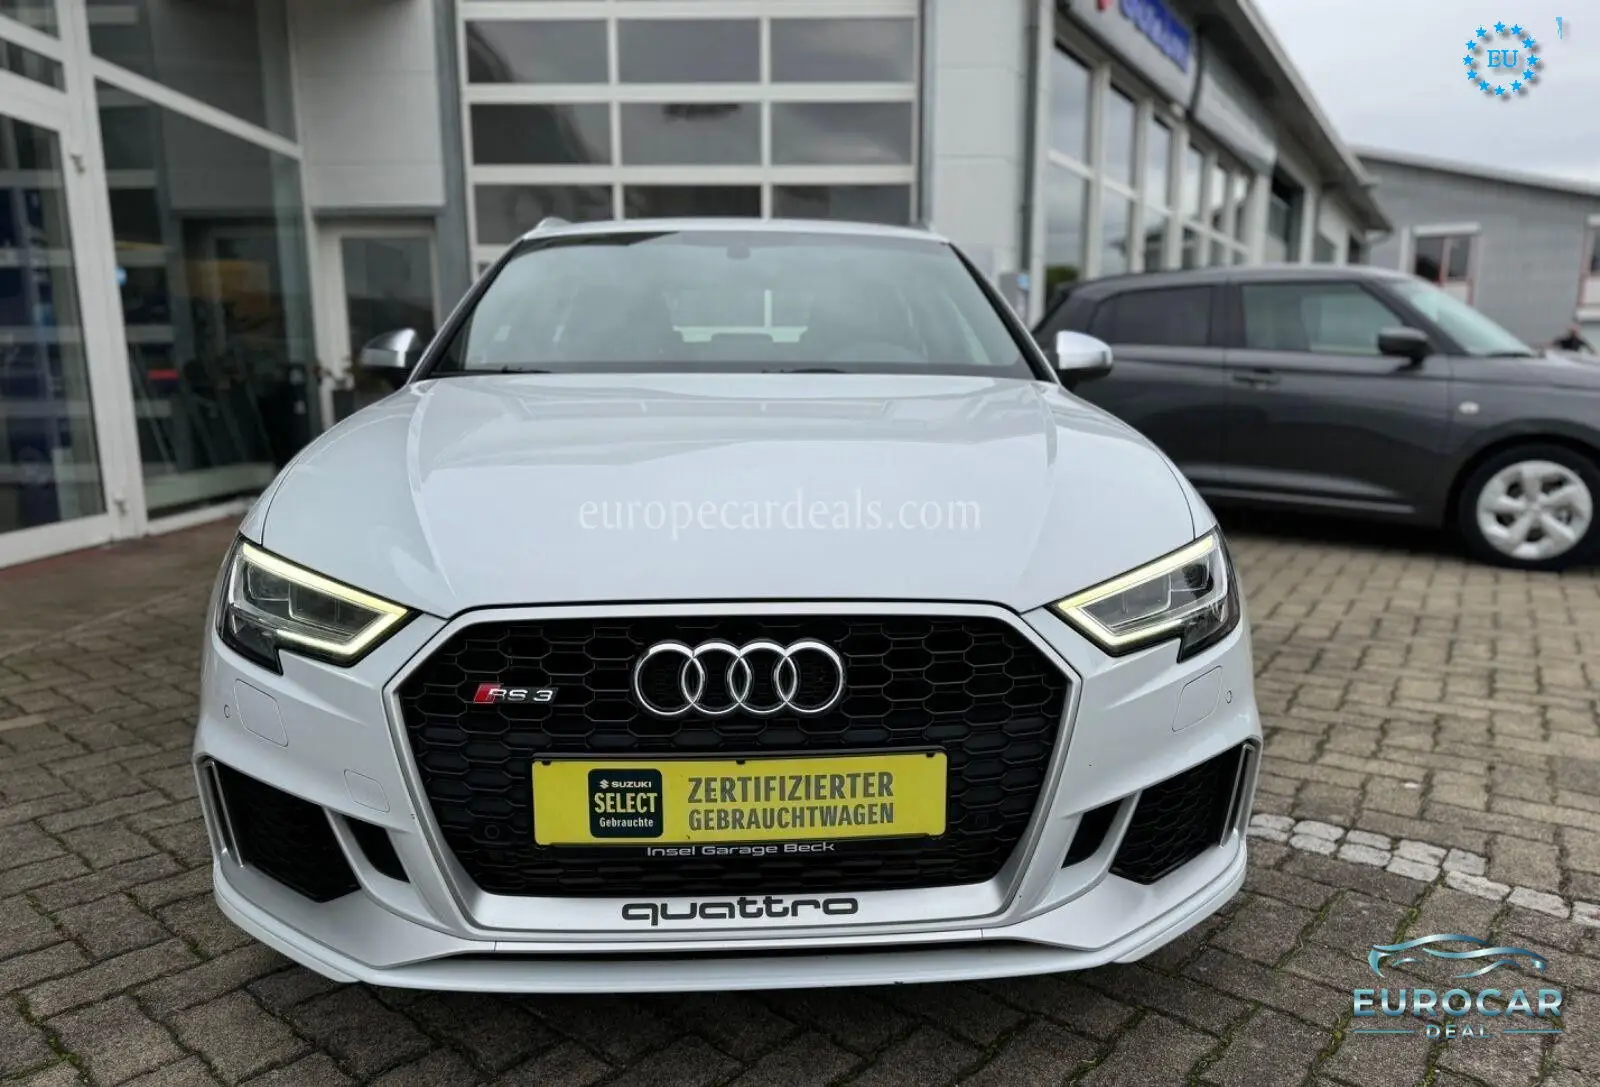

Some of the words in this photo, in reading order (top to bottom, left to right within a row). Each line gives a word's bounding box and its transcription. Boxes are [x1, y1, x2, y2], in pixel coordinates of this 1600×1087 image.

[482, 687, 529, 702] RS
[532, 689, 554, 702] 3
[687, 771, 894, 804] ZERTIFIZIERTER
[594, 792, 658, 813] SELECT
[600, 817, 654, 828] Gebrauchte
[688, 802, 894, 832] GEBRAUCHTWAGEN
[647, 846, 696, 857] Insel
[702, 845, 778, 857] Garage
[784, 841, 836, 853] Beck
[621, 896, 859, 926] quattro
